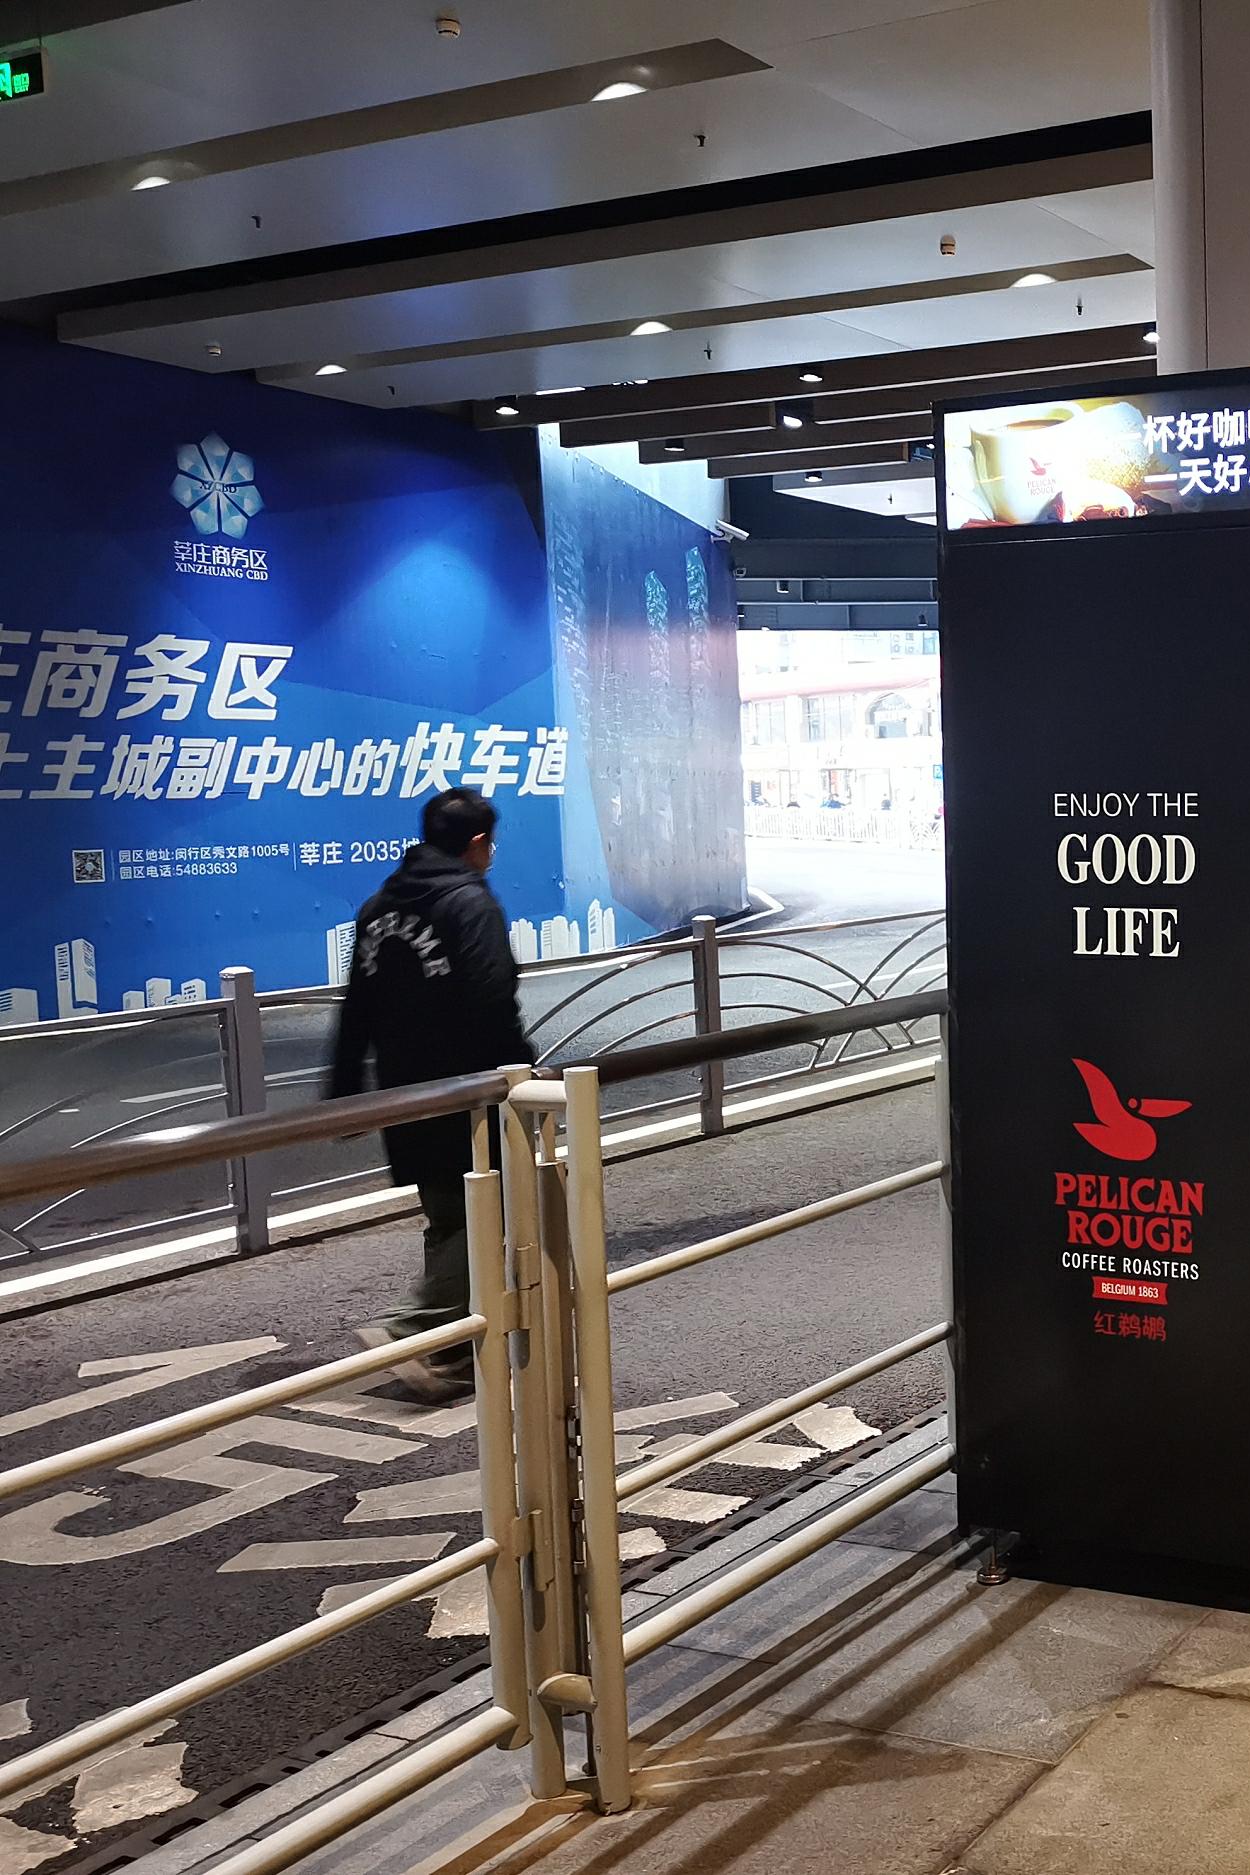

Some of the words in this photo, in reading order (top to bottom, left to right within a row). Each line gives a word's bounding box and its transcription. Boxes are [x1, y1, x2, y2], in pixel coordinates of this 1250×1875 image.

[174, 540, 268, 571] 莘庄商务区
[175, 561, 243, 579] XINZHUANG
[246, 569, 268, 581] CBD
[1054, 793, 1139, 817] ENJOY
[1147, 793, 1199, 817] THE
[300, 842, 344, 866] 莘庄
[1057, 833, 1196, 885] GOOD
[1073, 907, 1180, 957] LIFE
[1054, 1172, 1205, 1216] PELICAN
[1067, 1210, 1193, 1254] ROUGE
[1062, 1252, 1116, 1272] COFFEE
[1123, 1257, 1199, 1280] ROASTERS
[1101, 1282, 1136, 1296] BELGIUM
[1138, 1286, 1159, 1299] 1863
[1094, 1310, 1167, 1342] 红鹈鹕
